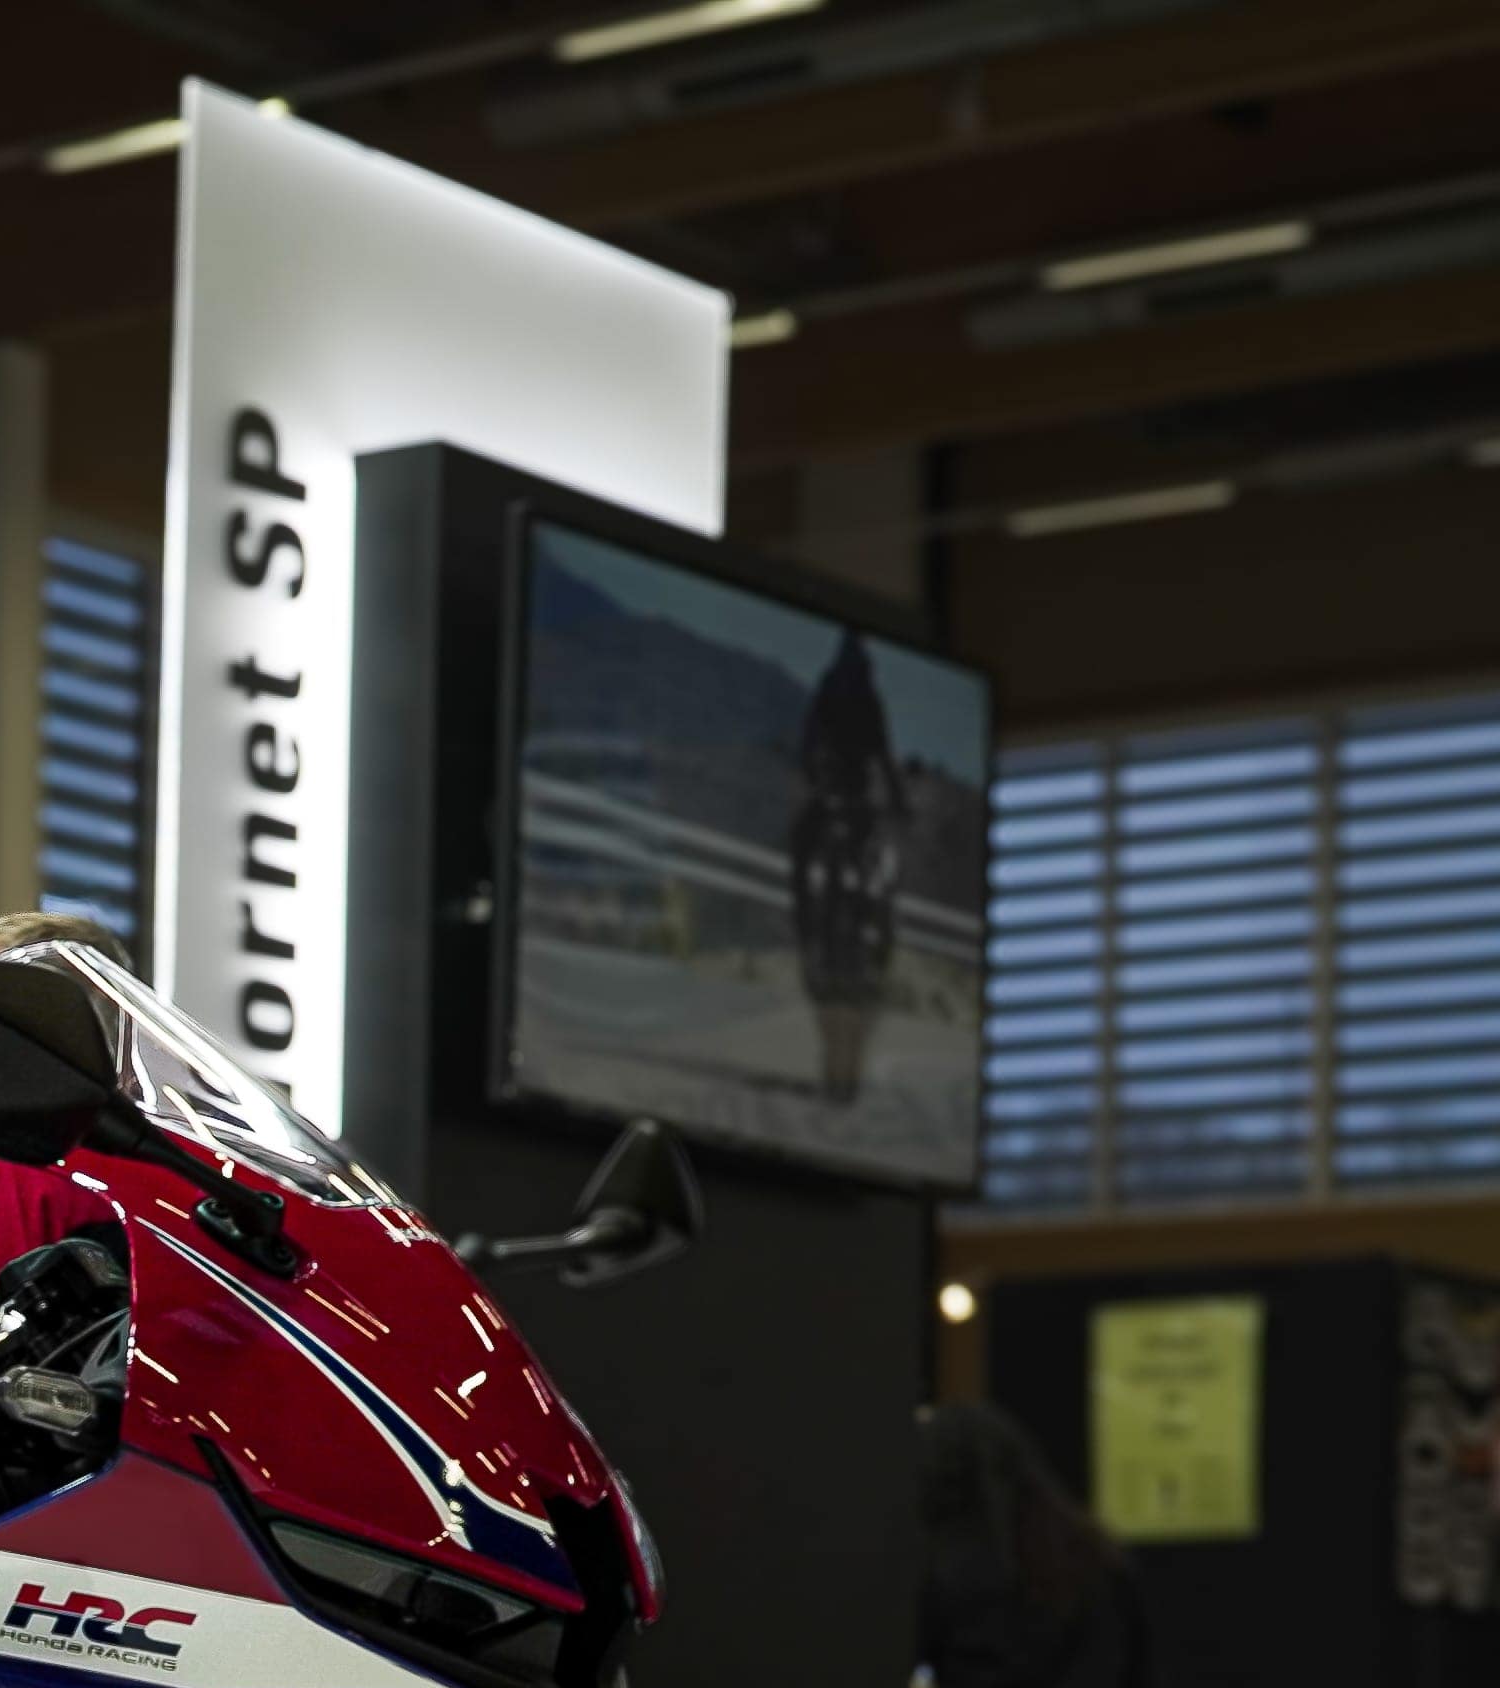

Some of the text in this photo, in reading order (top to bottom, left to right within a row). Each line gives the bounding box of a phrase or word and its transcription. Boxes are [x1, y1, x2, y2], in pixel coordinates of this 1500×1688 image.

[225, 404, 308, 1108] ornet SP
[0, 1629, 178, 1673] Honda RACING
[4, 1583, 198, 1657] HRC
